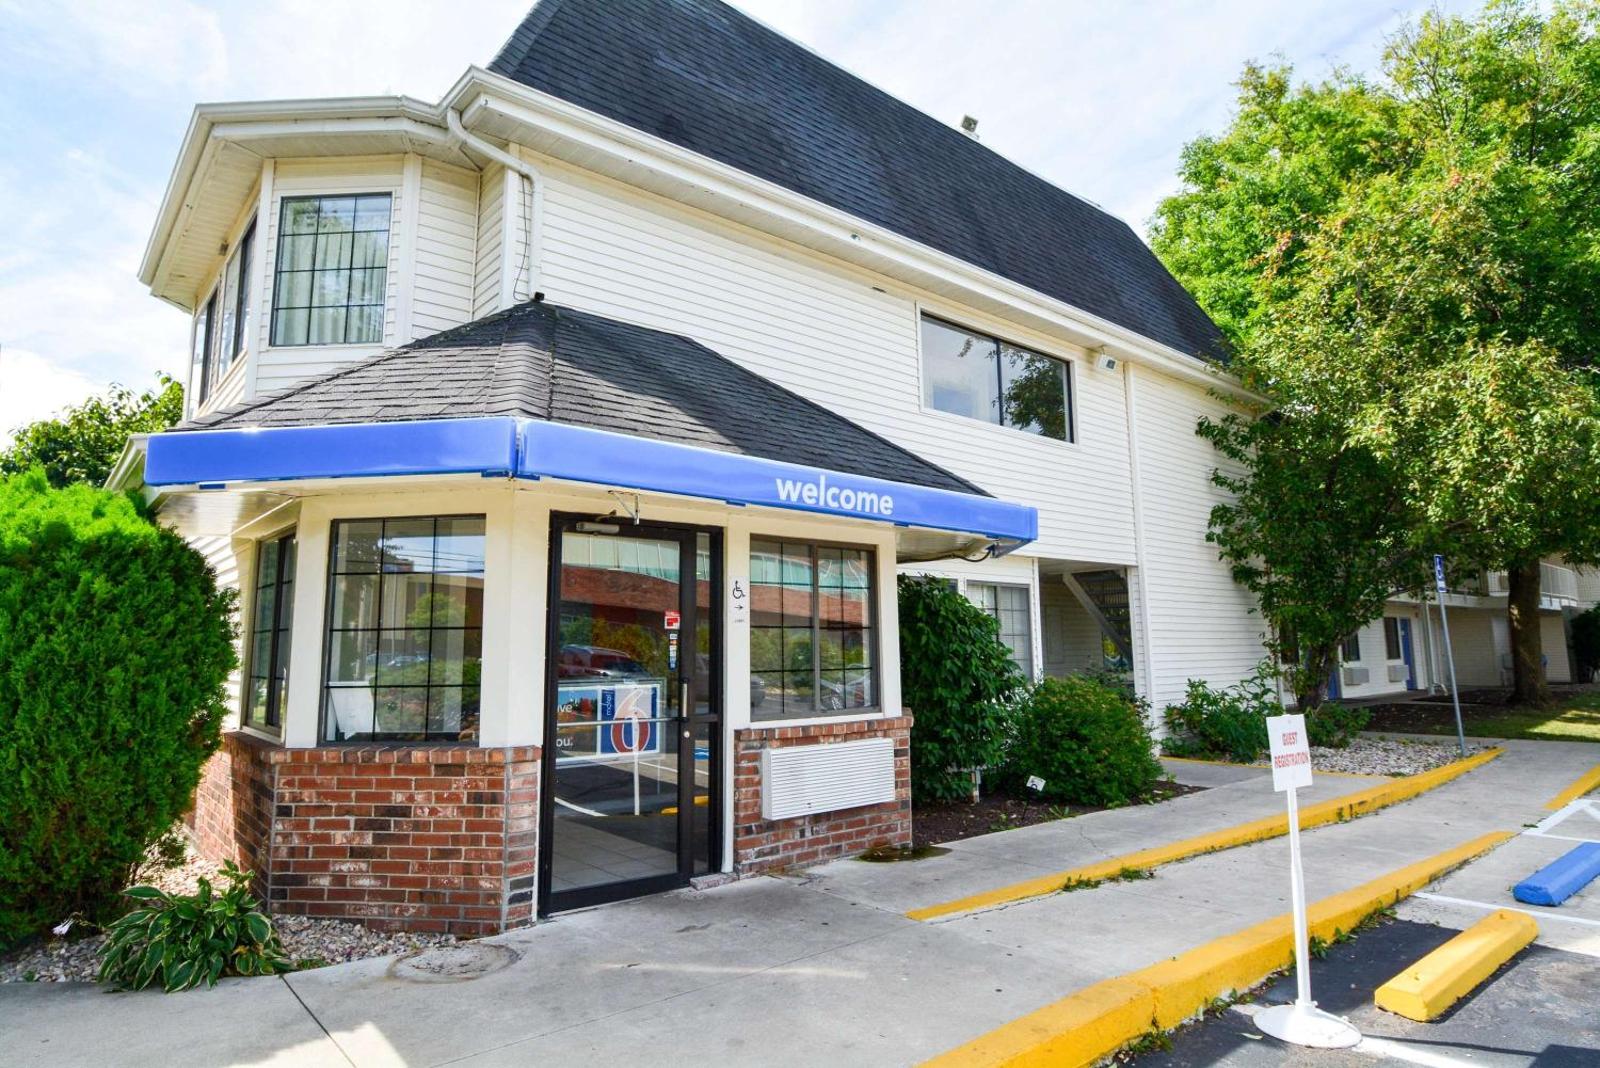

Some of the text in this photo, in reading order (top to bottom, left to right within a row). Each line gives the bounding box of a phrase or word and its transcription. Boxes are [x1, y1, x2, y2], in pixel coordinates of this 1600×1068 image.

[776, 474, 894, 515] welcome
[611, 689, 650, 753] 6
[1282, 732, 1297, 746] GUEST
[1274, 752, 1309, 768] REGISTRATION
